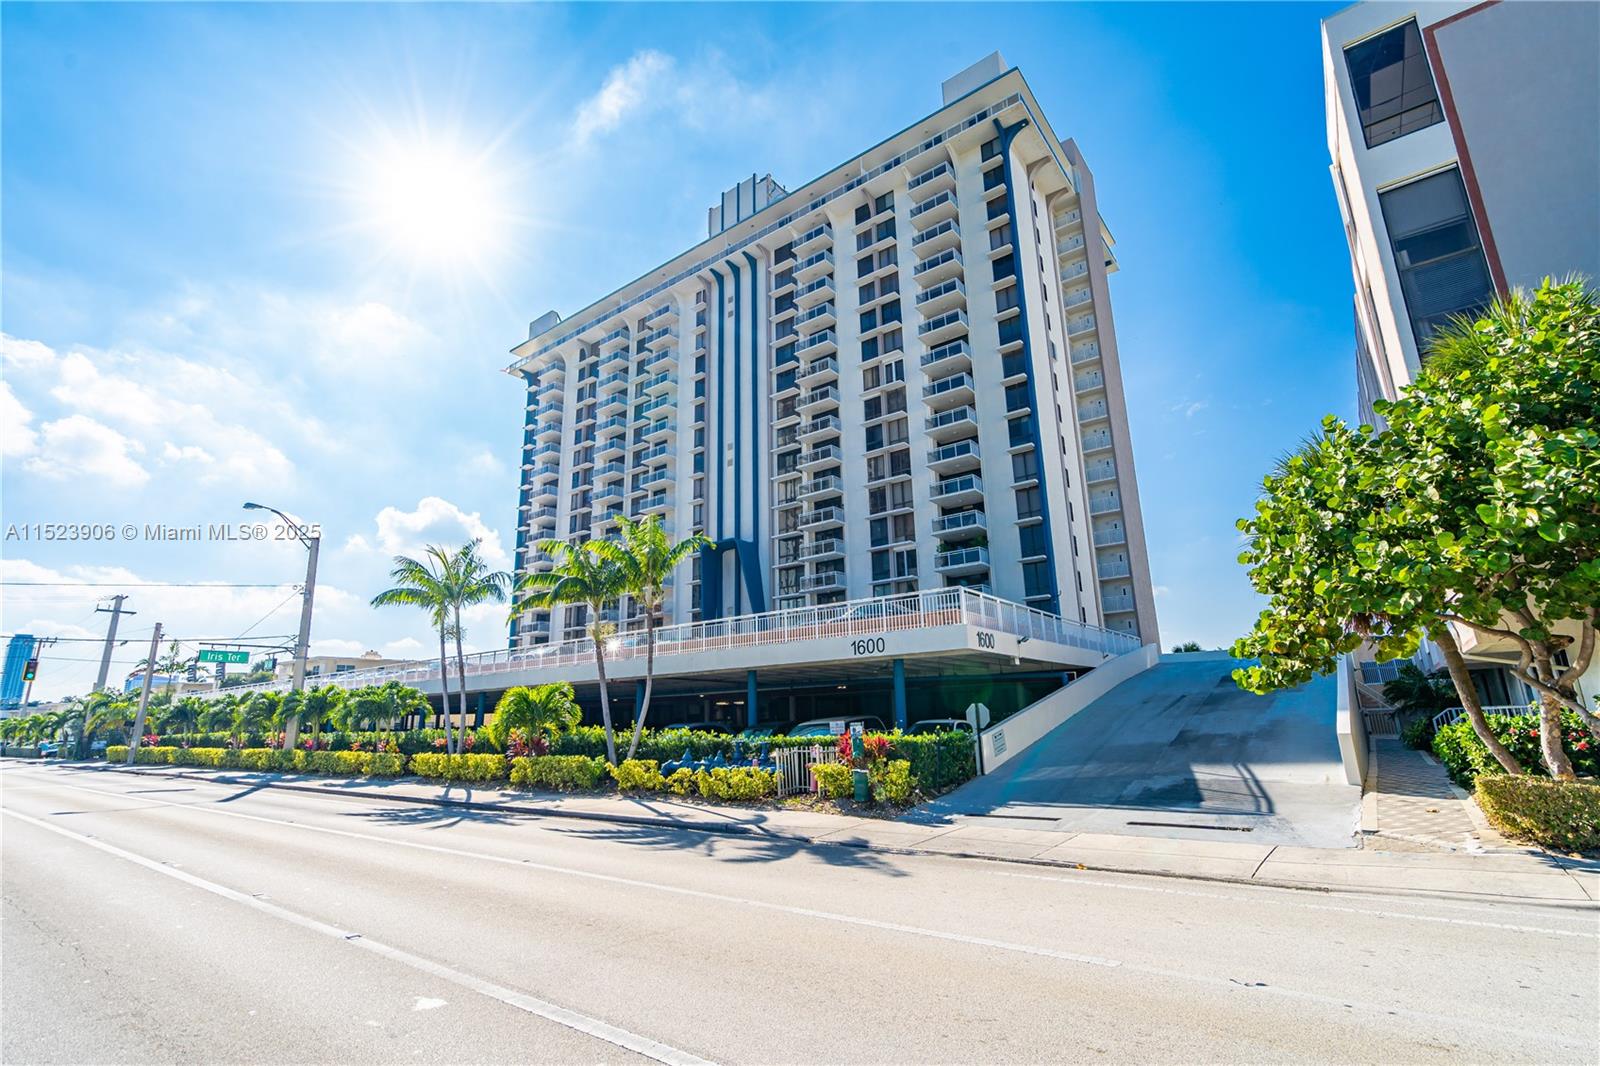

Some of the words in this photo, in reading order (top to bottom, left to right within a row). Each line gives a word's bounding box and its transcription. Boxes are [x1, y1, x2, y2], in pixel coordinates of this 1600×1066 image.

[850, 637, 886, 656] 1600
[976, 631, 995, 649] 1600
[207, 652, 223, 661] Iris
[227, 653, 241, 662] Ter
